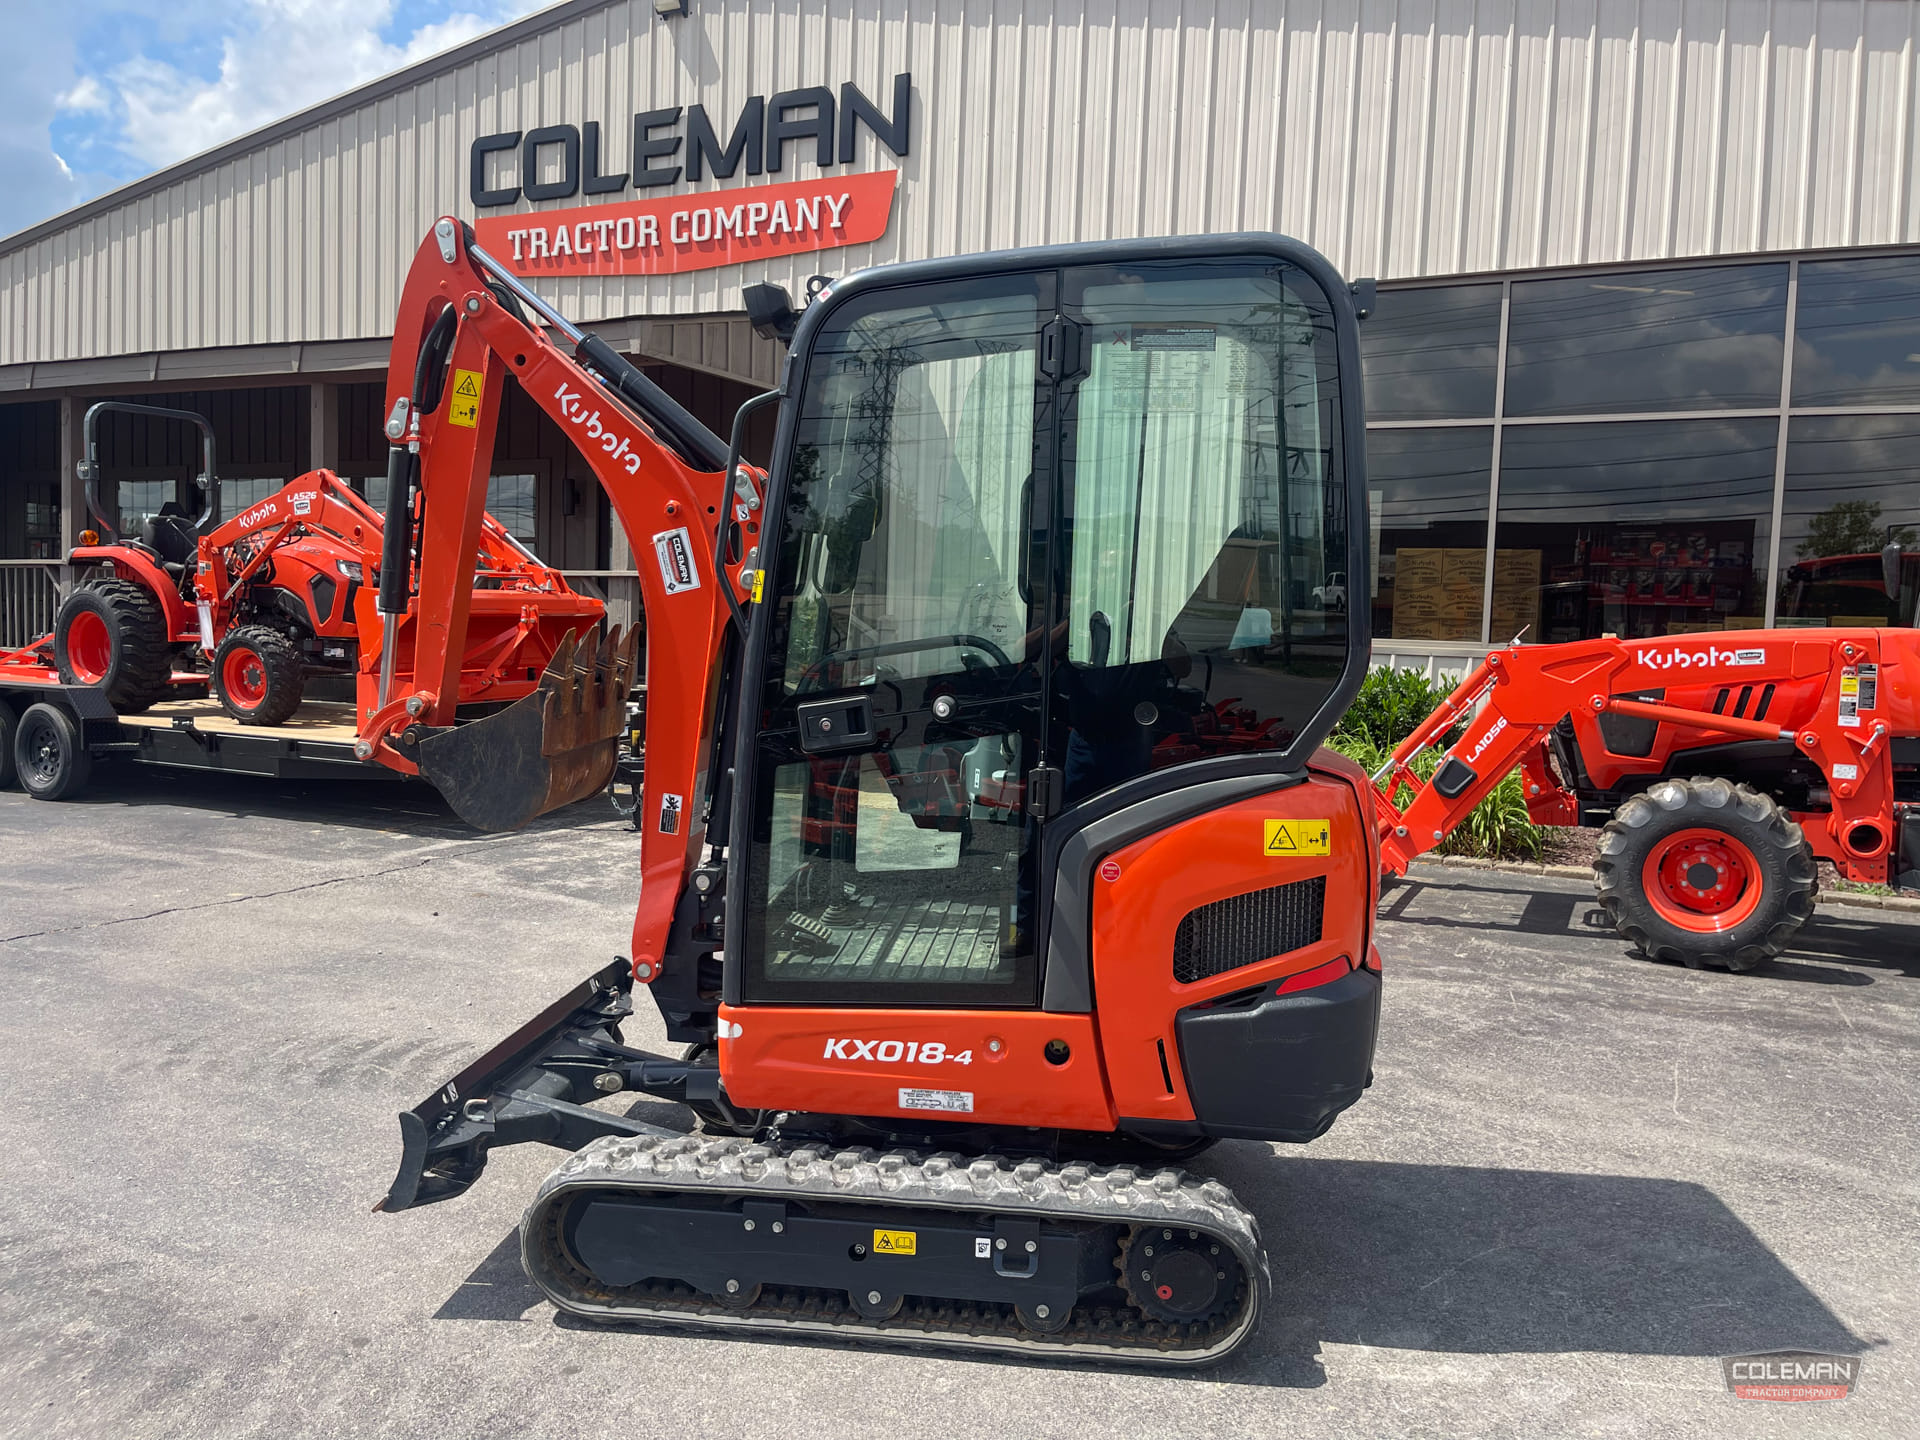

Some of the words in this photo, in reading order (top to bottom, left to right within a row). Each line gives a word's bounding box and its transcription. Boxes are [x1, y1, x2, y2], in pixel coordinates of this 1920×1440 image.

[470, 72, 910, 207] COLEMAN
[507, 214, 660, 261] TRACTOR
[670, 192, 851, 245] COMPANY
[553, 382, 641, 476] Kubota
[238, 503, 277, 528] Kubota
[287, 491, 317, 503] LA526
[671, 536, 690, 583] COLEMAN
[1637, 646, 1736, 669] Kubota
[1466, 716, 1507, 763] LA1056
[823, 1038, 973, 1065] KX018-4
